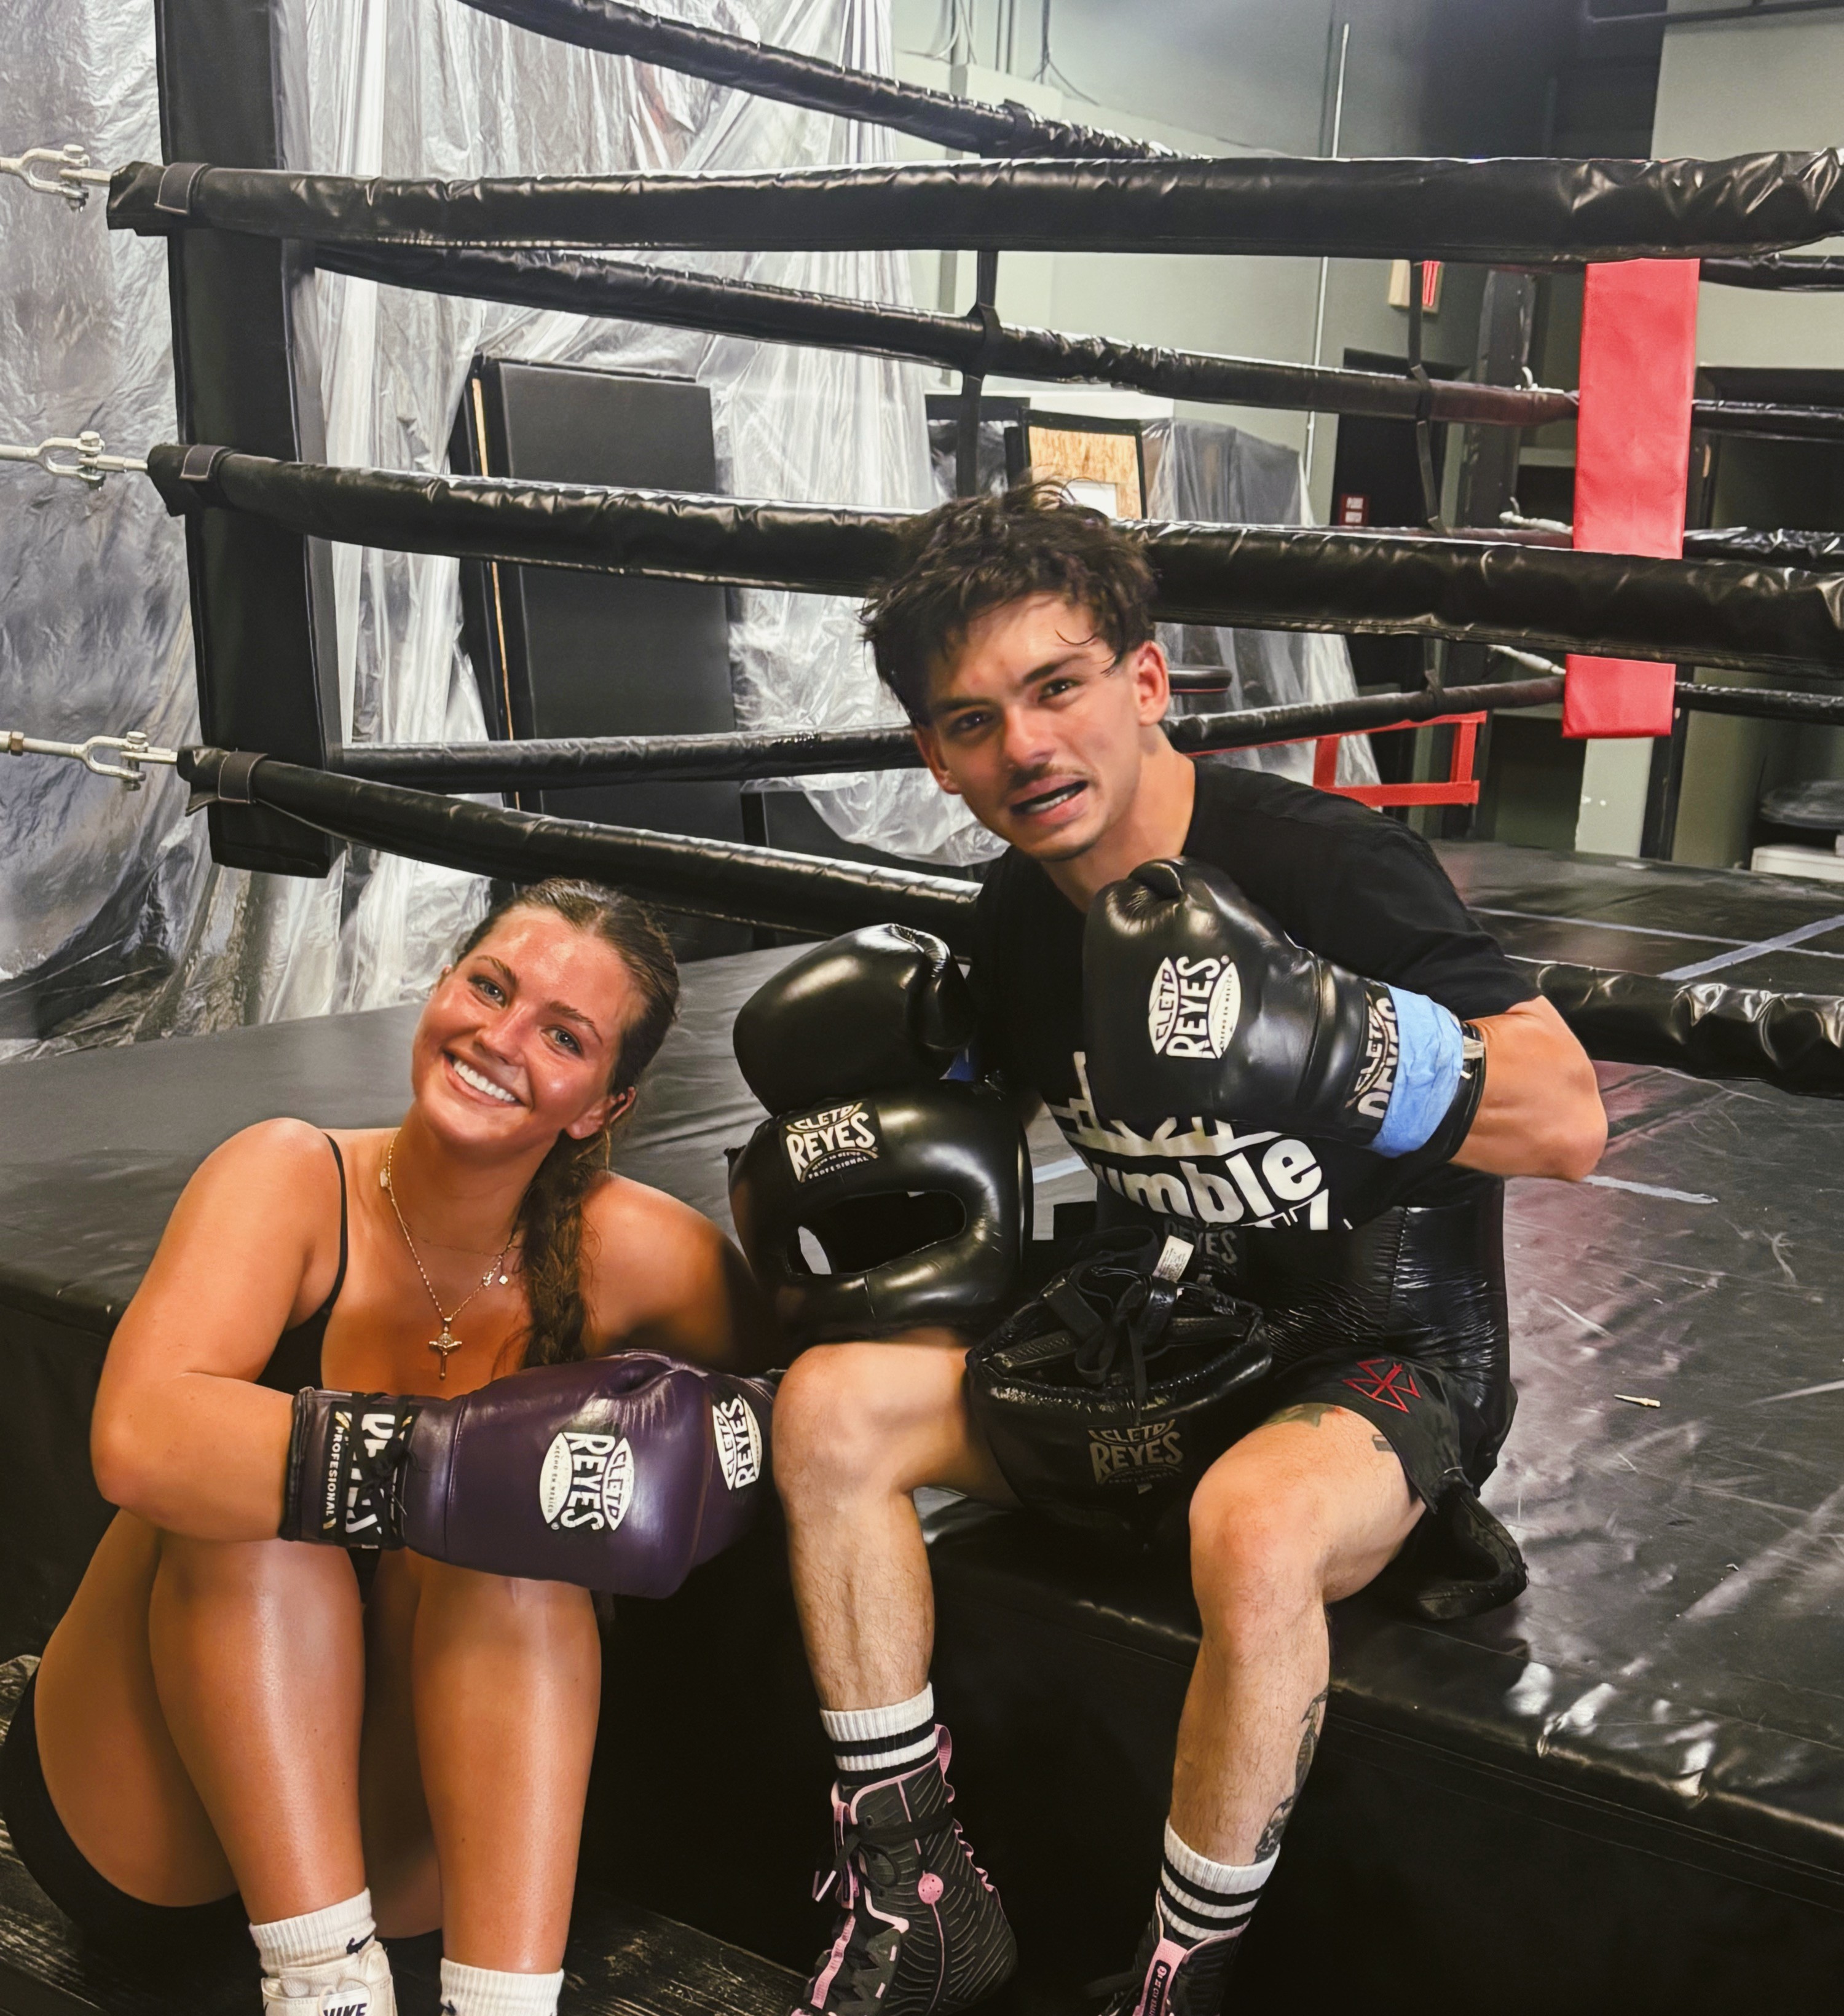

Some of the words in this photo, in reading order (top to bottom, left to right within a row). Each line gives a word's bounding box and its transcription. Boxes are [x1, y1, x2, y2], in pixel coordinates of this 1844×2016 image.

[1156, 968, 1175, 1041] CLETO
[1166, 956, 1221, 1058] REYES
[786, 1112, 875, 1182] REYES
[794, 1104, 854, 1130] CLETO
[1076, 1140, 1323, 1223] umble
[717, 1416, 735, 1478] CLETO
[720, 1398, 757, 1488] REYES
[1089, 1431, 1183, 1484] REYES
[1100, 1423, 1167, 1443] CLETO
[326, 1426, 345, 1516] PROFESIONAL
[561, 1432, 616, 1530] REYES
[606, 1451, 627, 1519] CLETO
